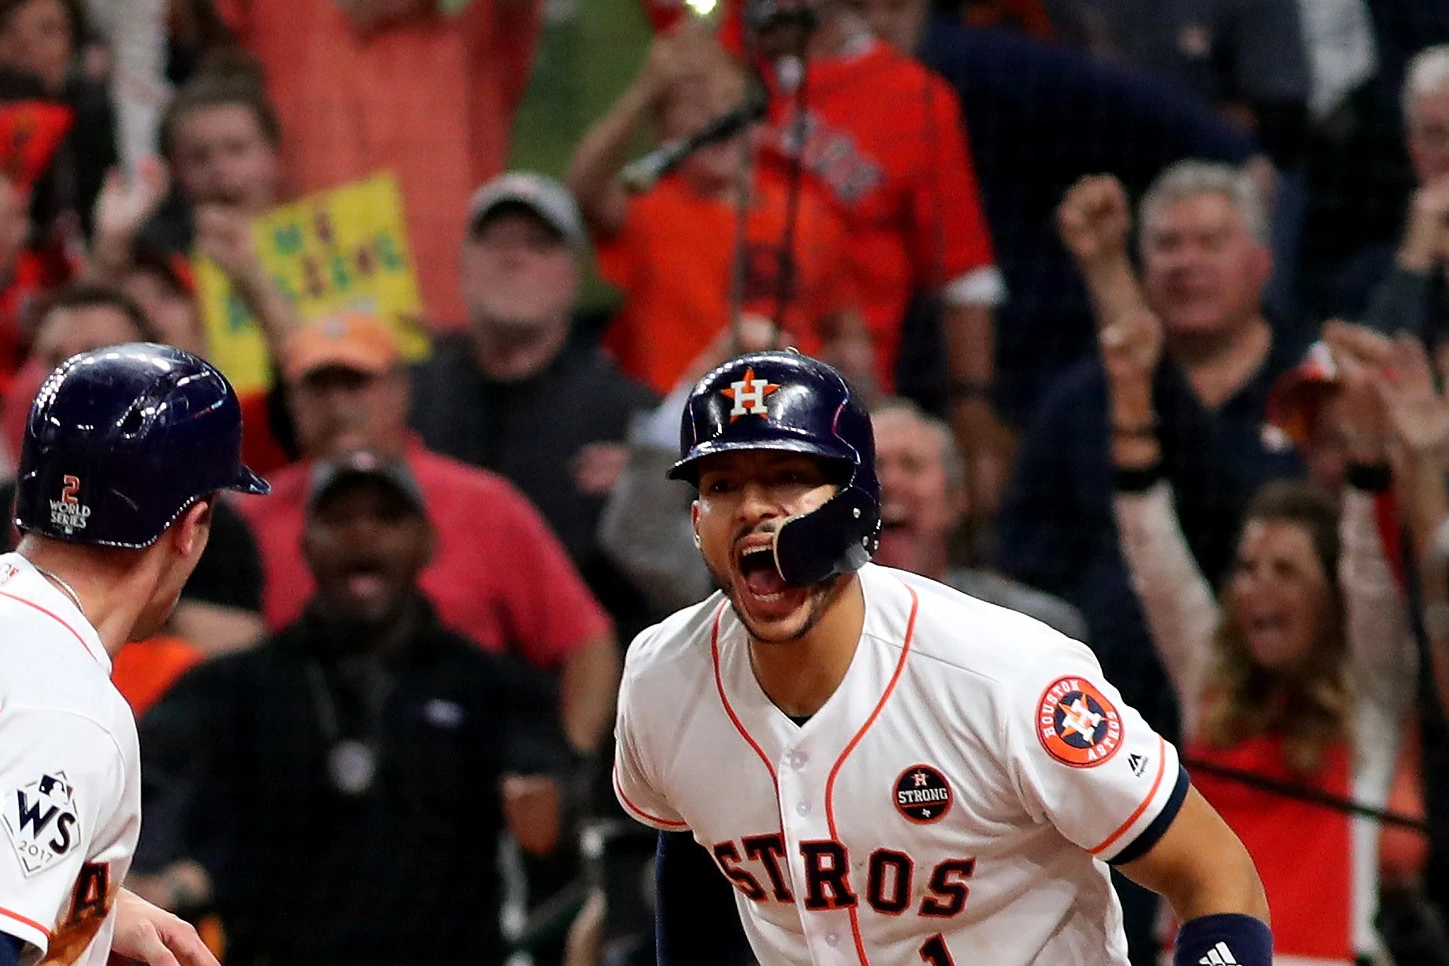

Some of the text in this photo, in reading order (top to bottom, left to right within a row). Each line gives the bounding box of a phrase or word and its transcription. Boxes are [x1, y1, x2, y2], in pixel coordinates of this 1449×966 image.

[731, 379, 769, 416] H
[62, 474, 80, 504] 2
[49, 499, 91, 517] WORLD
[51, 511, 87, 529] SERIES
[1041, 679, 1080, 739] HOUSTON
[1088, 711, 1120, 761] ASTROS
[898, 787, 949, 804] STRONG
[17, 789, 76, 855] WS
[18, 840, 53, 864] 2017
